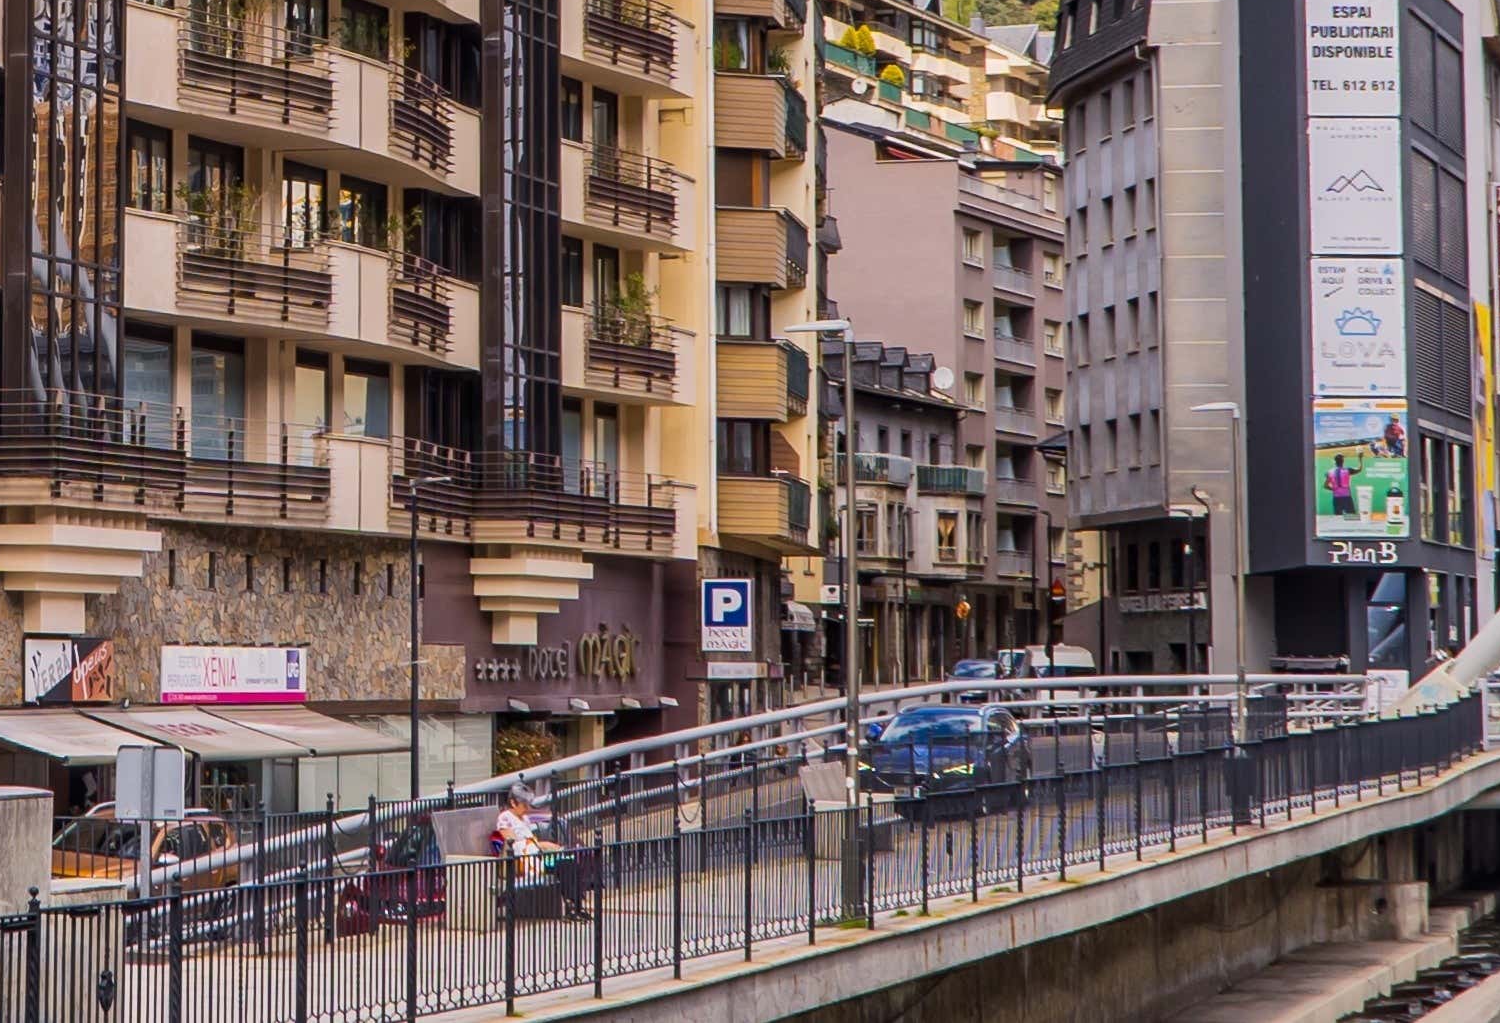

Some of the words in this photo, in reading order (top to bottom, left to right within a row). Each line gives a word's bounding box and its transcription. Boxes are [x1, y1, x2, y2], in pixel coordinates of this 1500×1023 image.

[1332, 6, 1372, 19] ESPAI
[1311, 26, 1394, 39] PUBLICITARI
[1312, 46, 1393, 58] DISPONIBLE
[1312, 80, 1338, 90] TEL.
[1343, 80, 1367, 91] 612
[1371, 81, 1395, 91] 612
[711, 587, 743, 623] P
